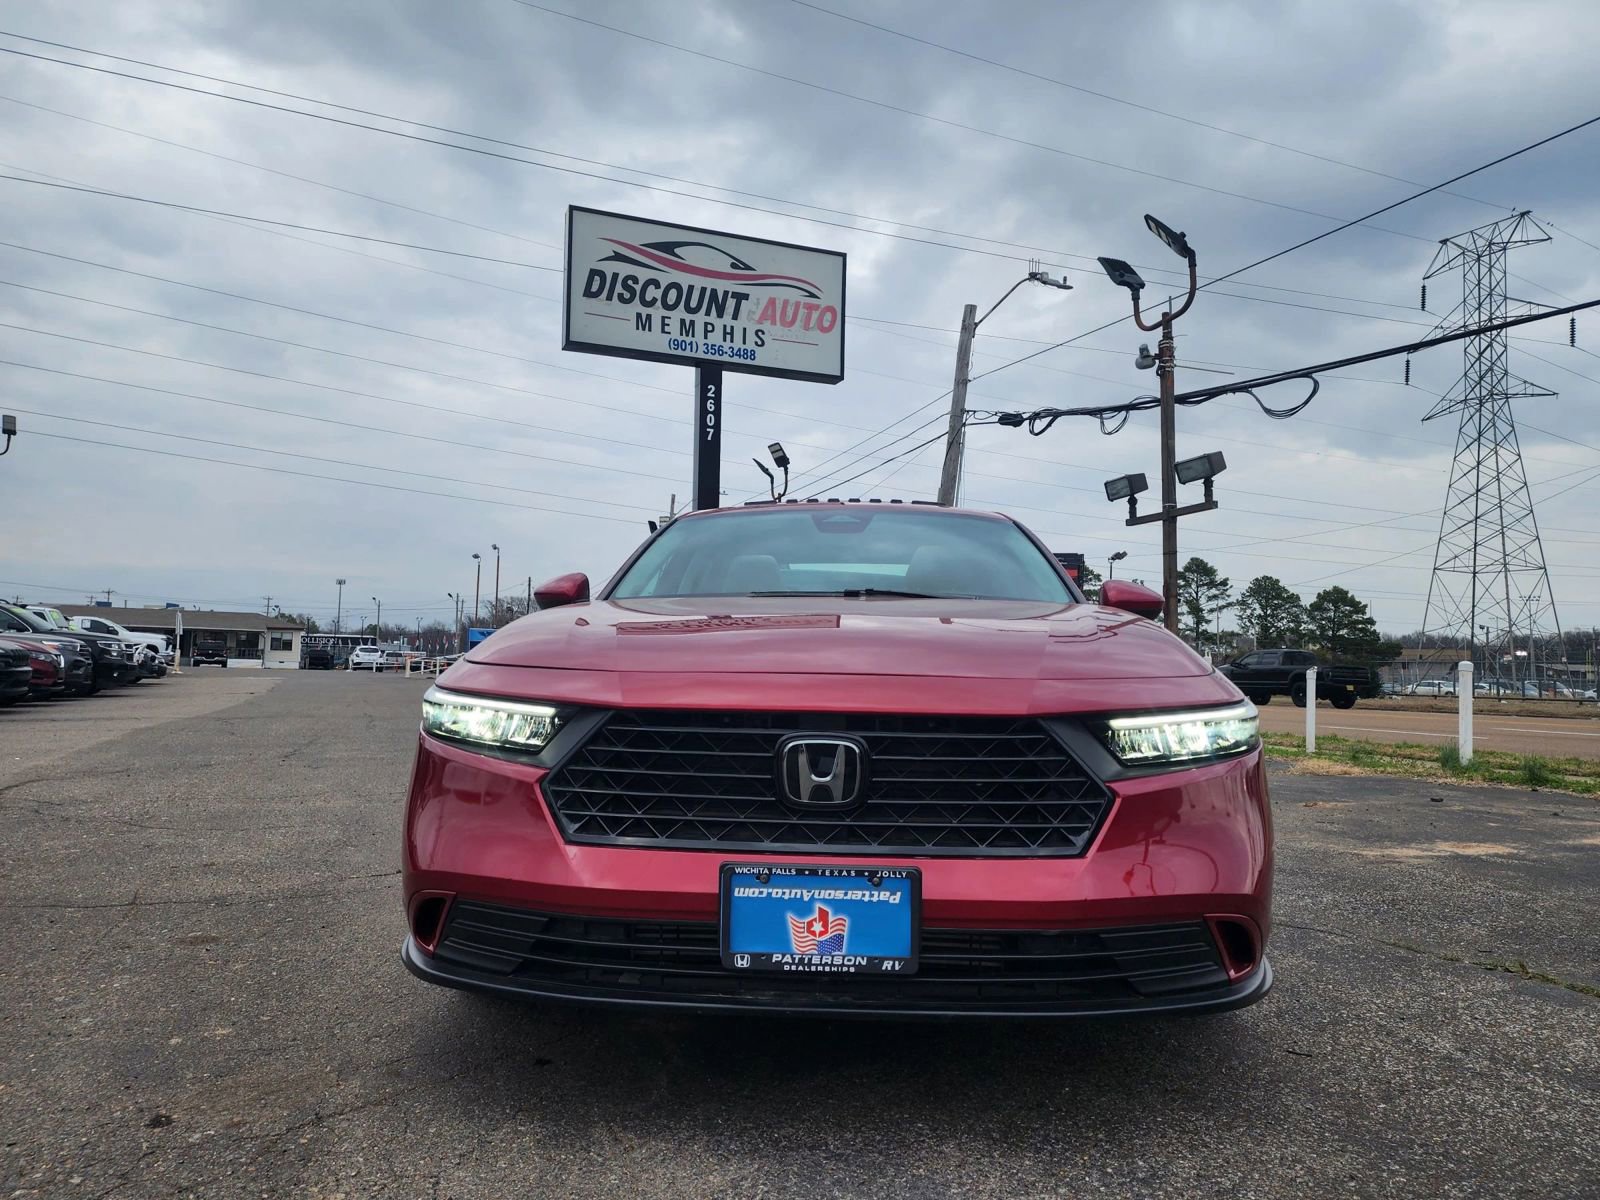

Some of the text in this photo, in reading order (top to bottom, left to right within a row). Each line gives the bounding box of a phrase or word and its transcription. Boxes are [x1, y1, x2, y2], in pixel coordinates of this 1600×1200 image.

[583, 268, 837, 334] DISCOUNT AUTO
[635, 312, 766, 348] MEMPHIS
[668, 337, 757, 361] (901) 356-3488
[706, 385, 716, 440] 2607
[735, 867, 769, 875] WICHITA
[817, 869, 856, 877] TEXAS
[876, 870, 907, 878] JOLLY
[734, 887, 902, 903] PattersonAuto.com
[771, 953, 904, 971] PATTERSON RV
[783, 965, 856, 973] DEALERSHIPS
